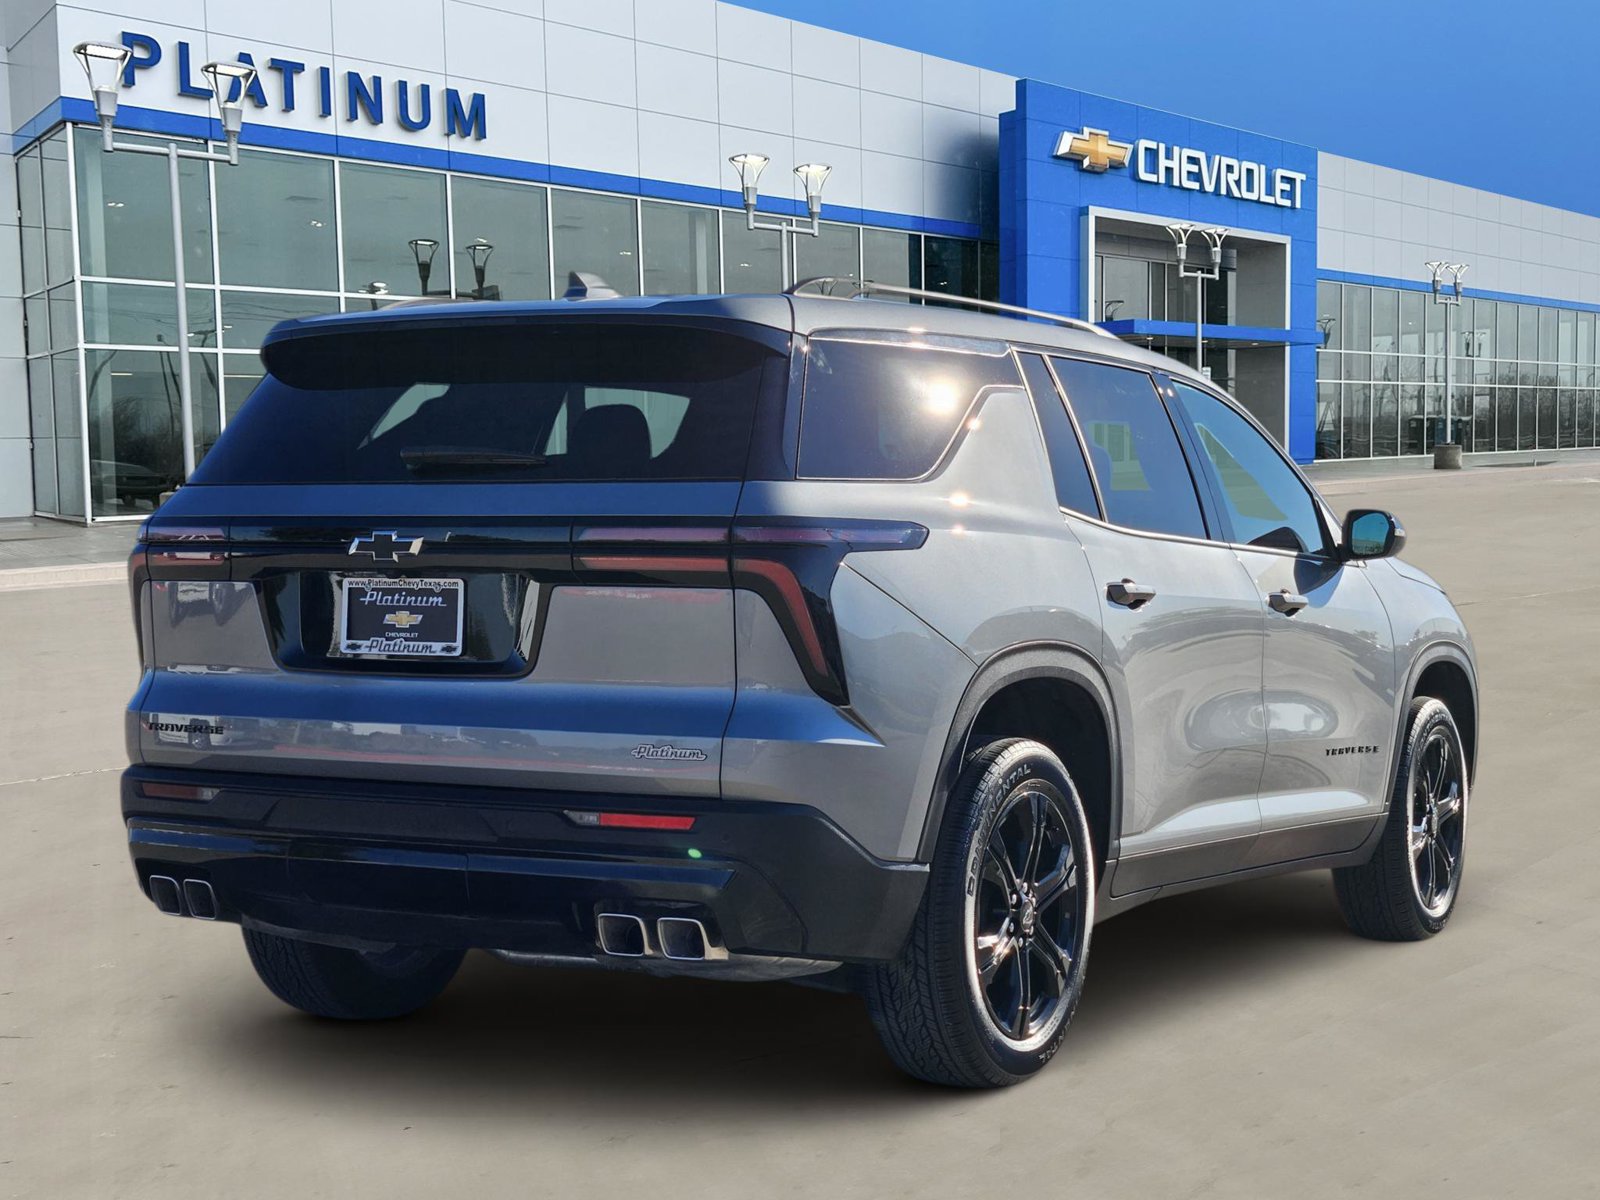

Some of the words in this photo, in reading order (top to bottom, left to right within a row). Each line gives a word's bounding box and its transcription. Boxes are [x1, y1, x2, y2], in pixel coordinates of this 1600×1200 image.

[119, 30, 488, 141] PLATINUM
[1136, 138, 1307, 209] CHEVROLET
[347, 578, 459, 589] www.PlatinumChevyTexas.com
[360, 591, 447, 607] Platinum
[365, 638, 437, 654] Platinum
[146, 721, 224, 735] TRAVERSE
[630, 743, 708, 761] Platinum
[1325, 745, 1380, 756] TRAVERSE
